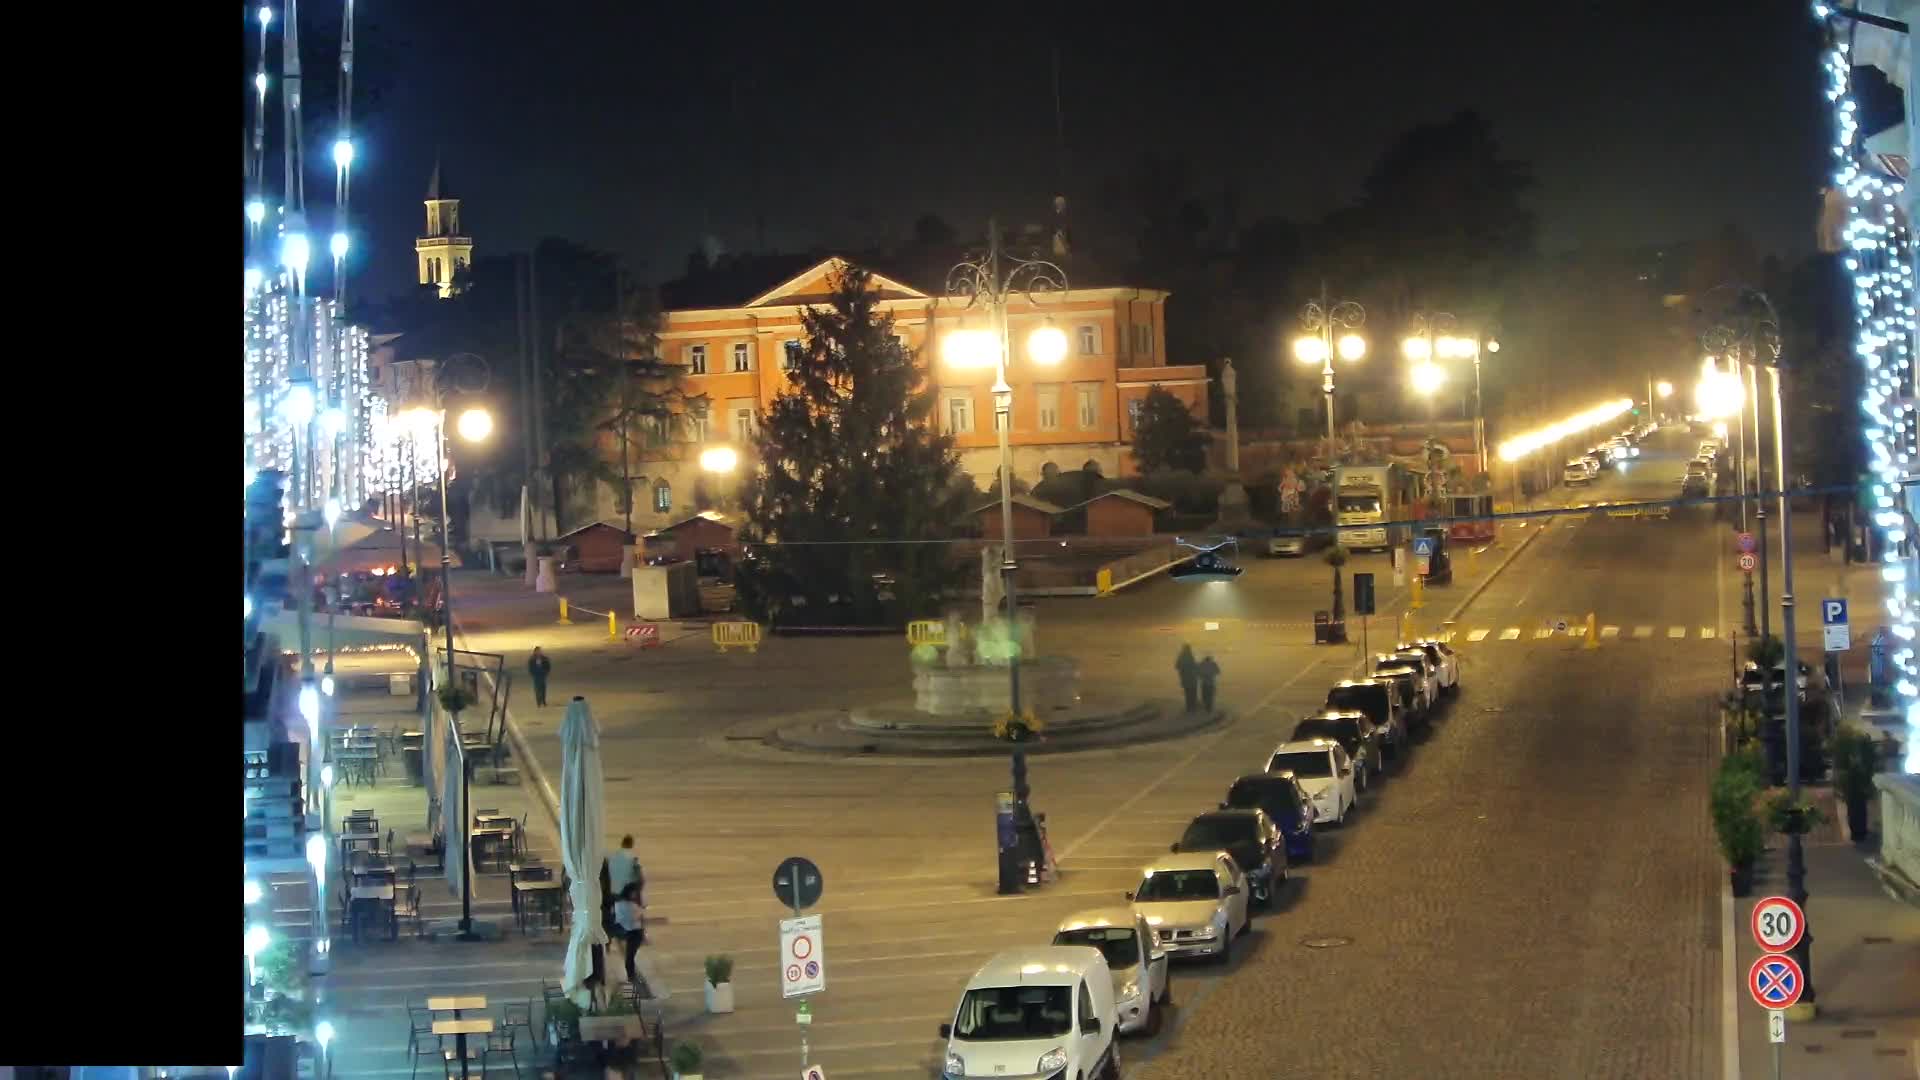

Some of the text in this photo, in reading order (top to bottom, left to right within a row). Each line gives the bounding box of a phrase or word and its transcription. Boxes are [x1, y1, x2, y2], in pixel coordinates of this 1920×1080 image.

[1743, 558, 1752, 567] 20
[1827, 602, 1842, 621] P
[1763, 912, 1791, 937] 30
